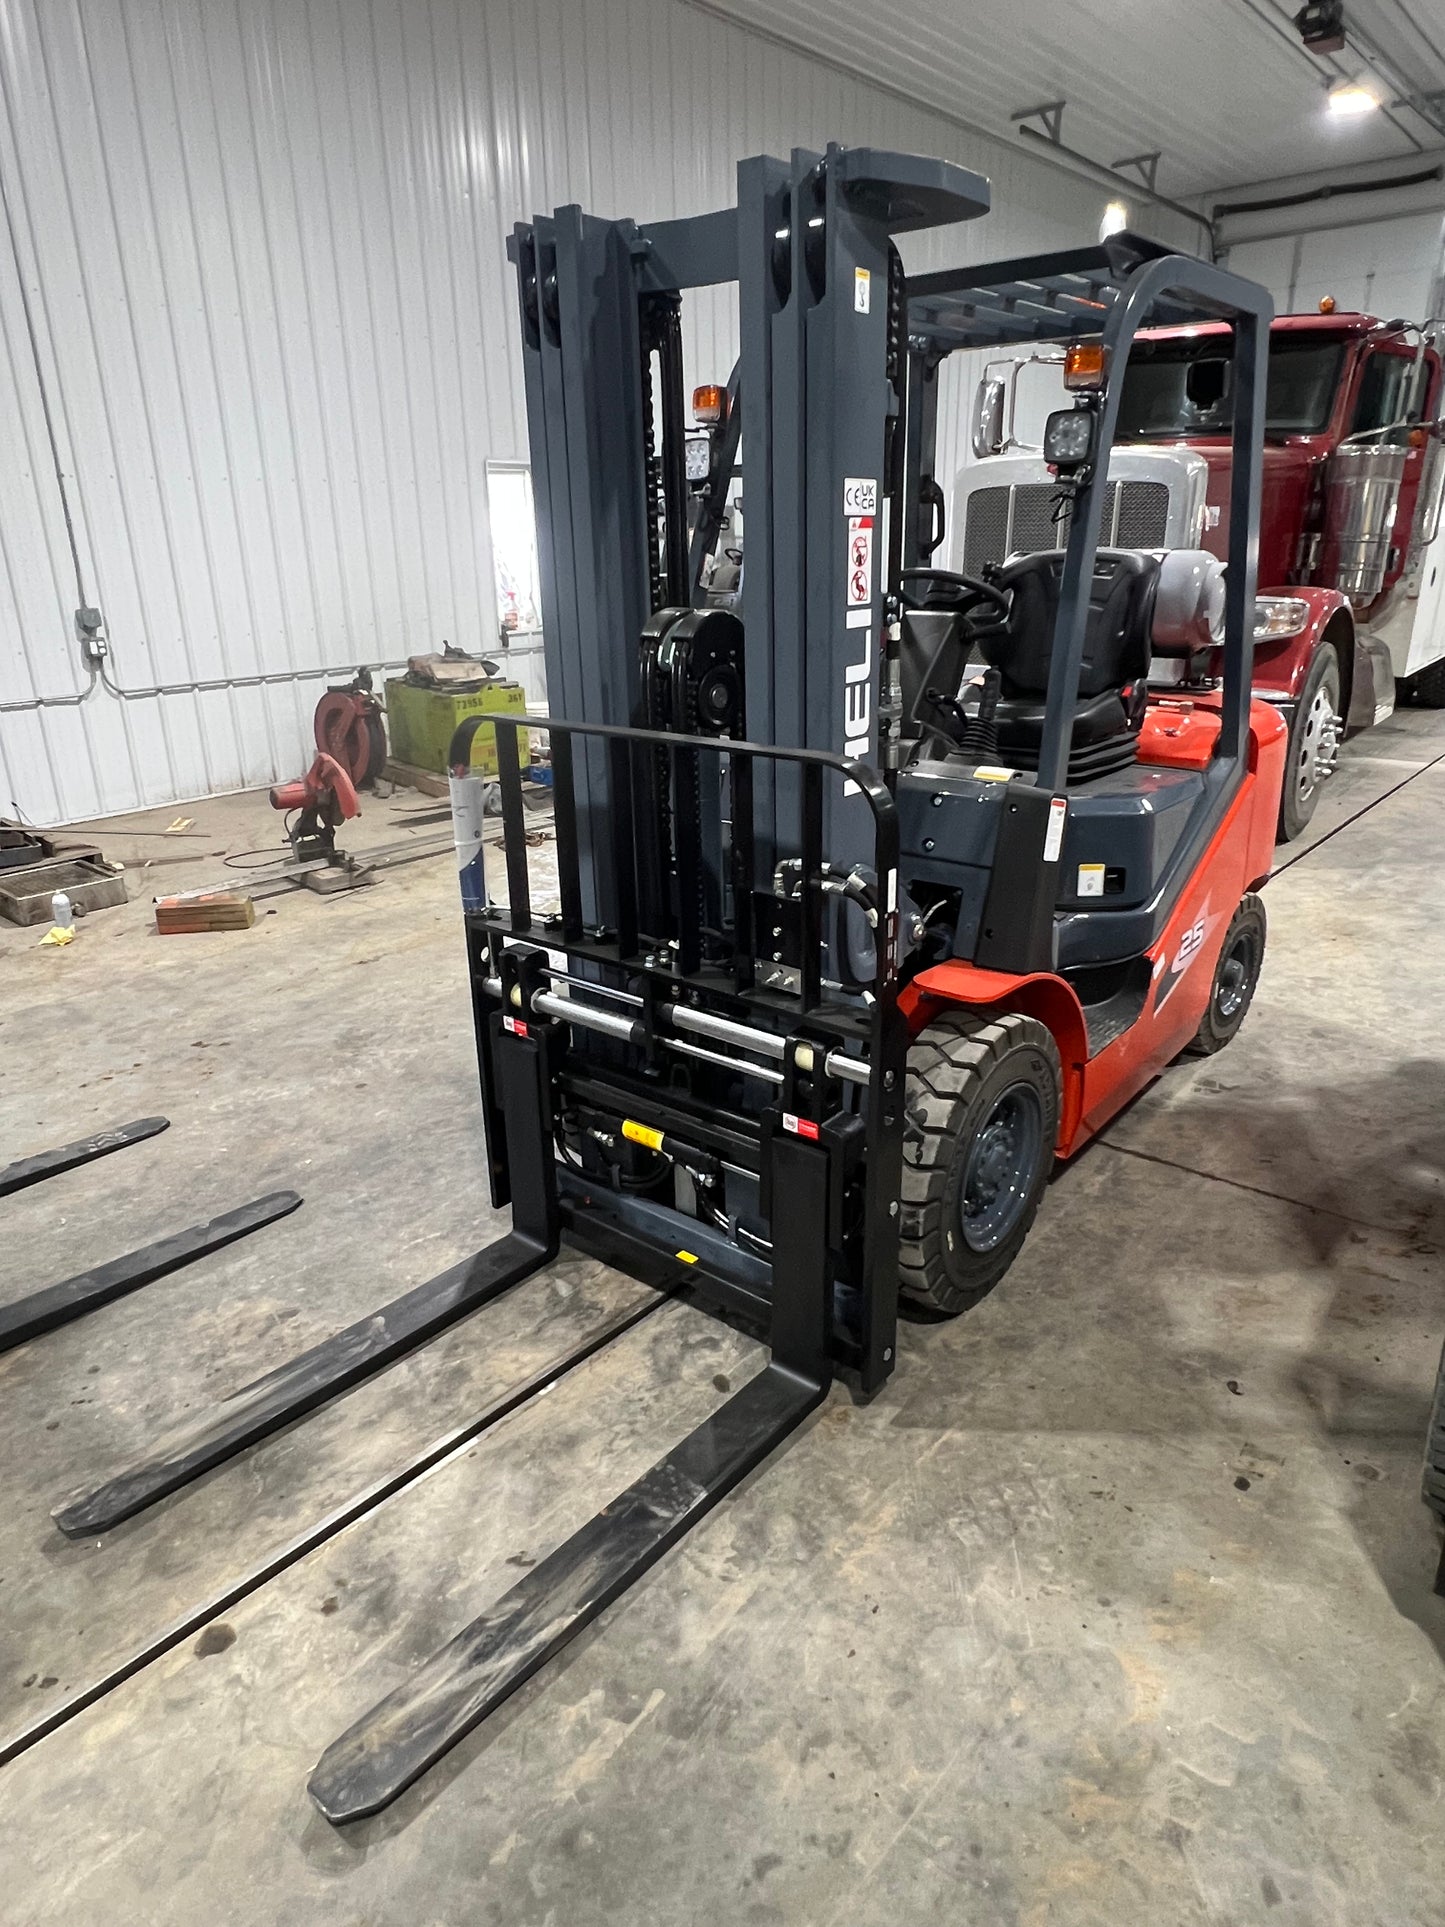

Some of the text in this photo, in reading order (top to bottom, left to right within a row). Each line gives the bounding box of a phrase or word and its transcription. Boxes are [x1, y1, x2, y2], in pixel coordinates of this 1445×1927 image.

[846, 487, 860, 506] CE
[861, 485, 875, 497] UK
[861, 498, 875, 510] CA
[1179, 917, 1206, 961] 25
